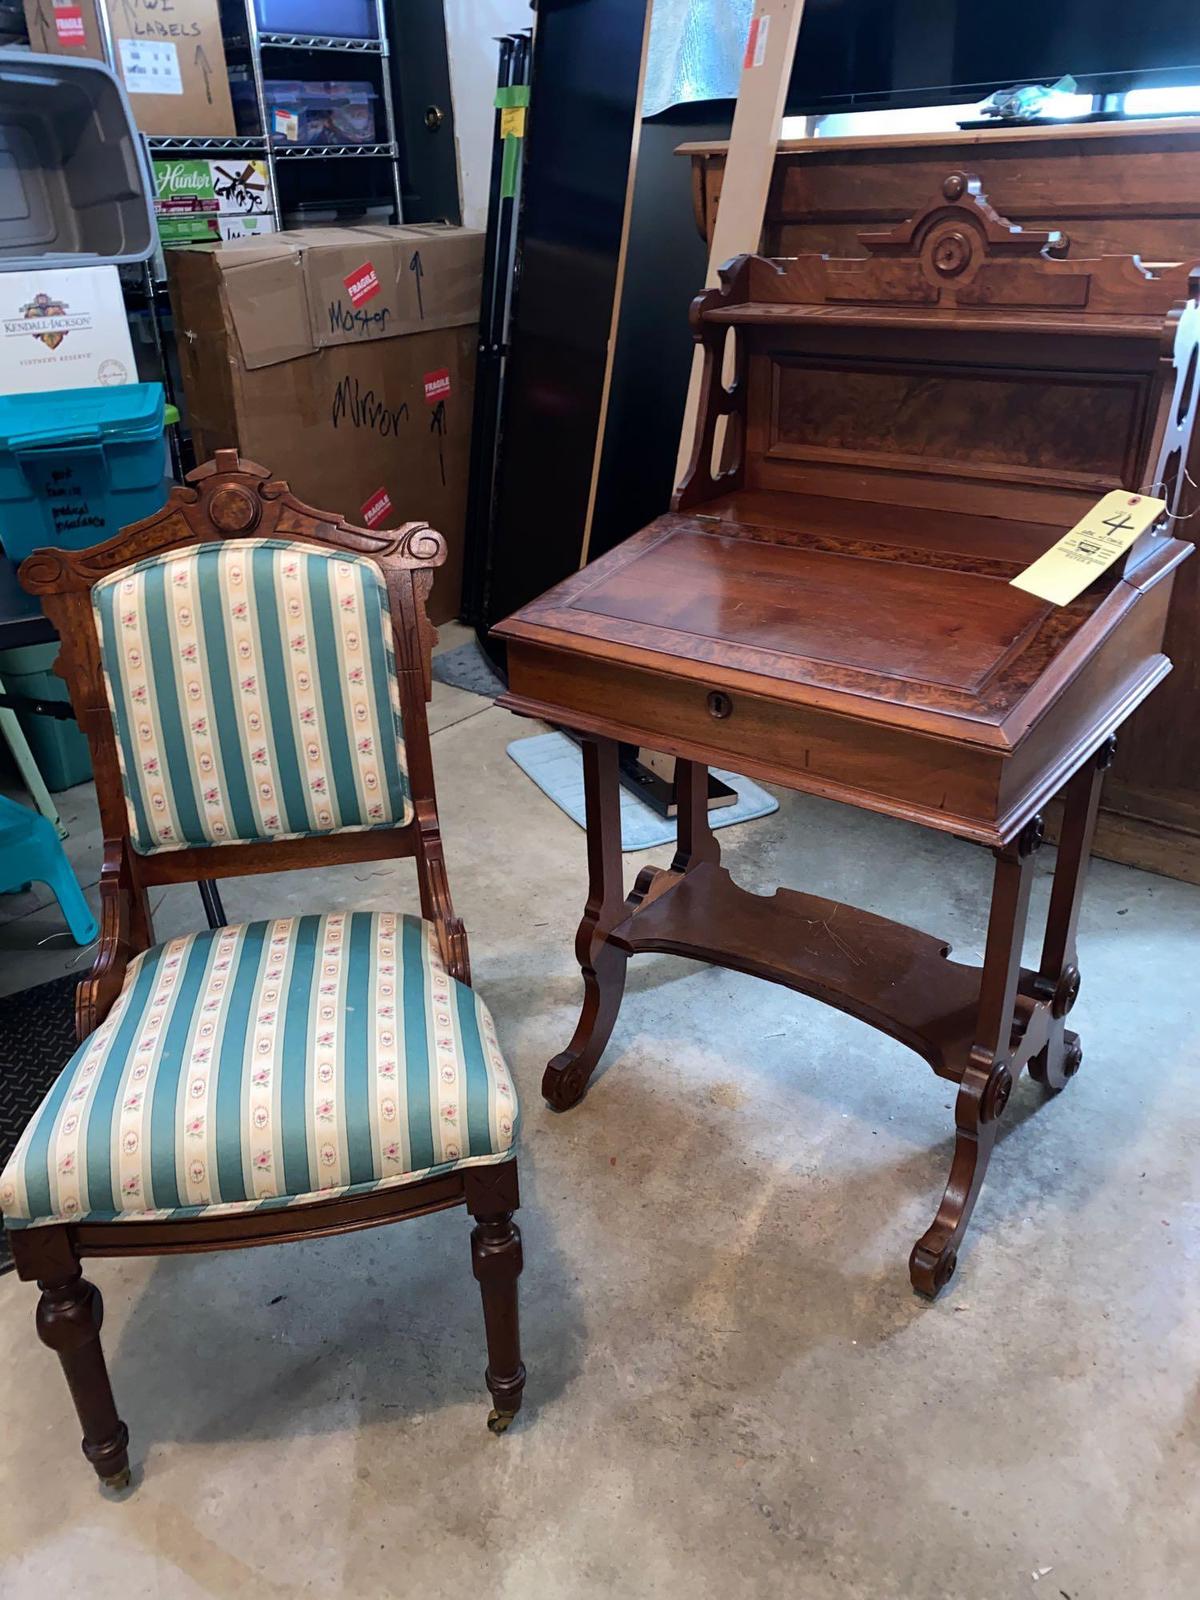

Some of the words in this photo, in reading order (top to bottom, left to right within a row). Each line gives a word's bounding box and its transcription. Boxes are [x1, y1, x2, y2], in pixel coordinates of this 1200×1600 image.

[135, 22, 201, 36] LABELS
[158, 164, 211, 192] Hunter
[347, 270, 377, 297] FRAGILE
[4, 317, 90, 333] KENDALL-JACKSON
[424, 376, 450, 393] FRAGILE
[333, 376, 409, 436] Mirror
[364, 494, 391, 522] FRAGILE
[1102, 512, 1135, 536] 4
